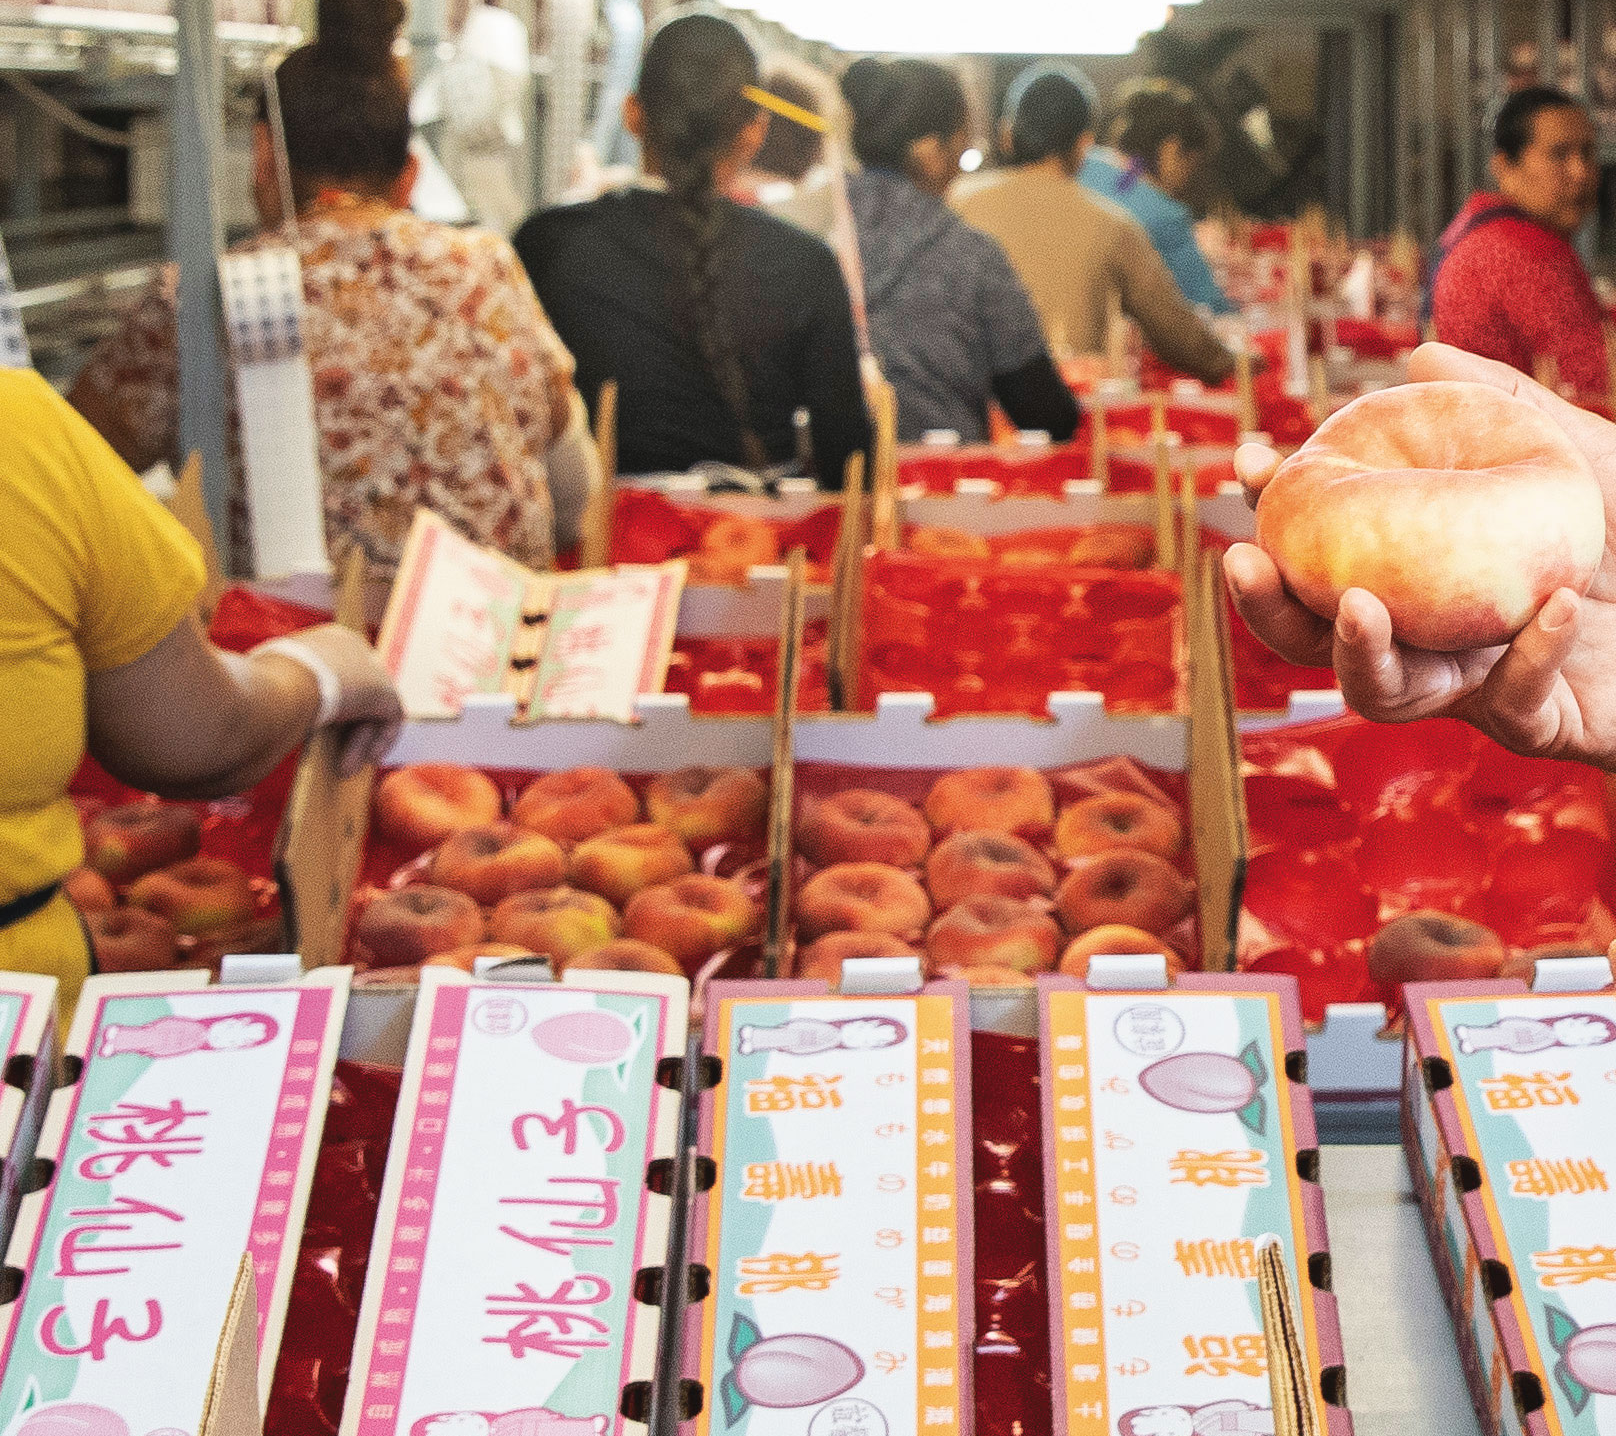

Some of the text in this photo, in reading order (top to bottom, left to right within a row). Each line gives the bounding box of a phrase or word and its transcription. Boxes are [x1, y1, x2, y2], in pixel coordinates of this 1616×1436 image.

[40, 1100, 211, 1362] 桃仙子
[483, 1098, 626, 1361] 桃仙子
